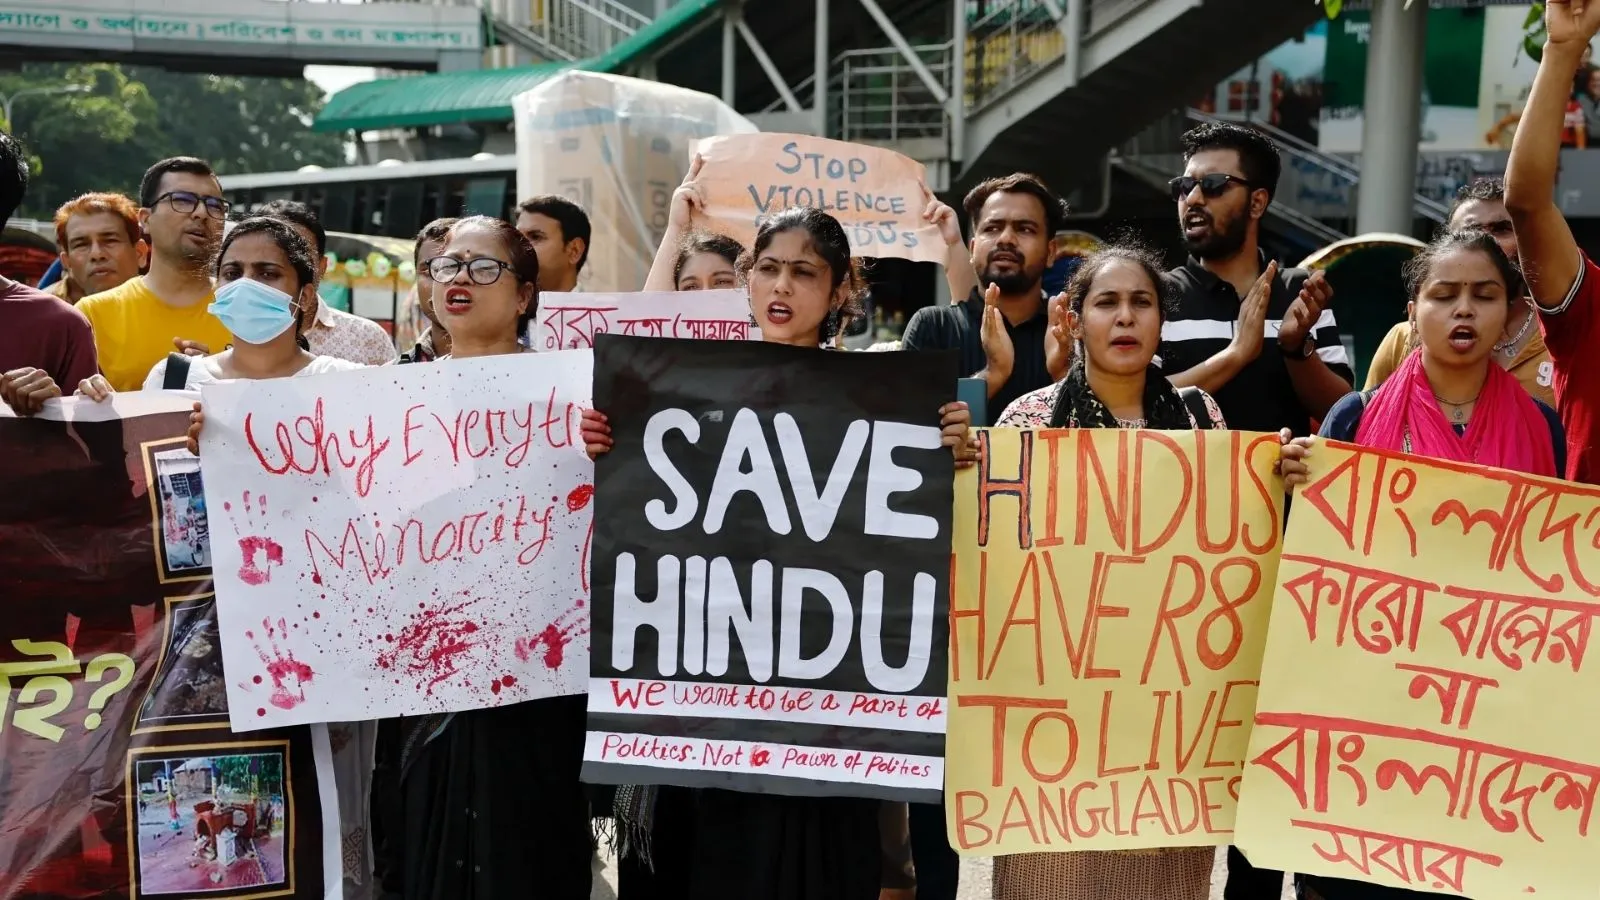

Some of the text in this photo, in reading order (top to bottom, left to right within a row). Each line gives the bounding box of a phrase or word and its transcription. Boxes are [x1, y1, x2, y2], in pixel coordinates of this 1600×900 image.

[747, 184, 907, 214] VIOLENCE
[776, 142, 867, 182] STOP
[245, 397, 390, 497] Why
[643, 407, 942, 542] SAVE
[977, 427, 1282, 556] HINDUS
[611, 552, 936, 692] HINDU
[949, 551, 1146, 686] HAVE
[1280, 554, 1600, 673] কারো বাপের
[744, 686, 775, 710] to
[781, 689, 813, 712] be
[821, 693, 840, 710] a
[917, 698, 942, 720] of
[957, 695, 1079, 787] TO
[1098, 680, 1256, 778] LIVE
[1395, 662, 1500, 730] না
[702, 742, 743, 766] Not
[844, 752, 863, 774] of
[1290, 819, 1503, 893] সবার
